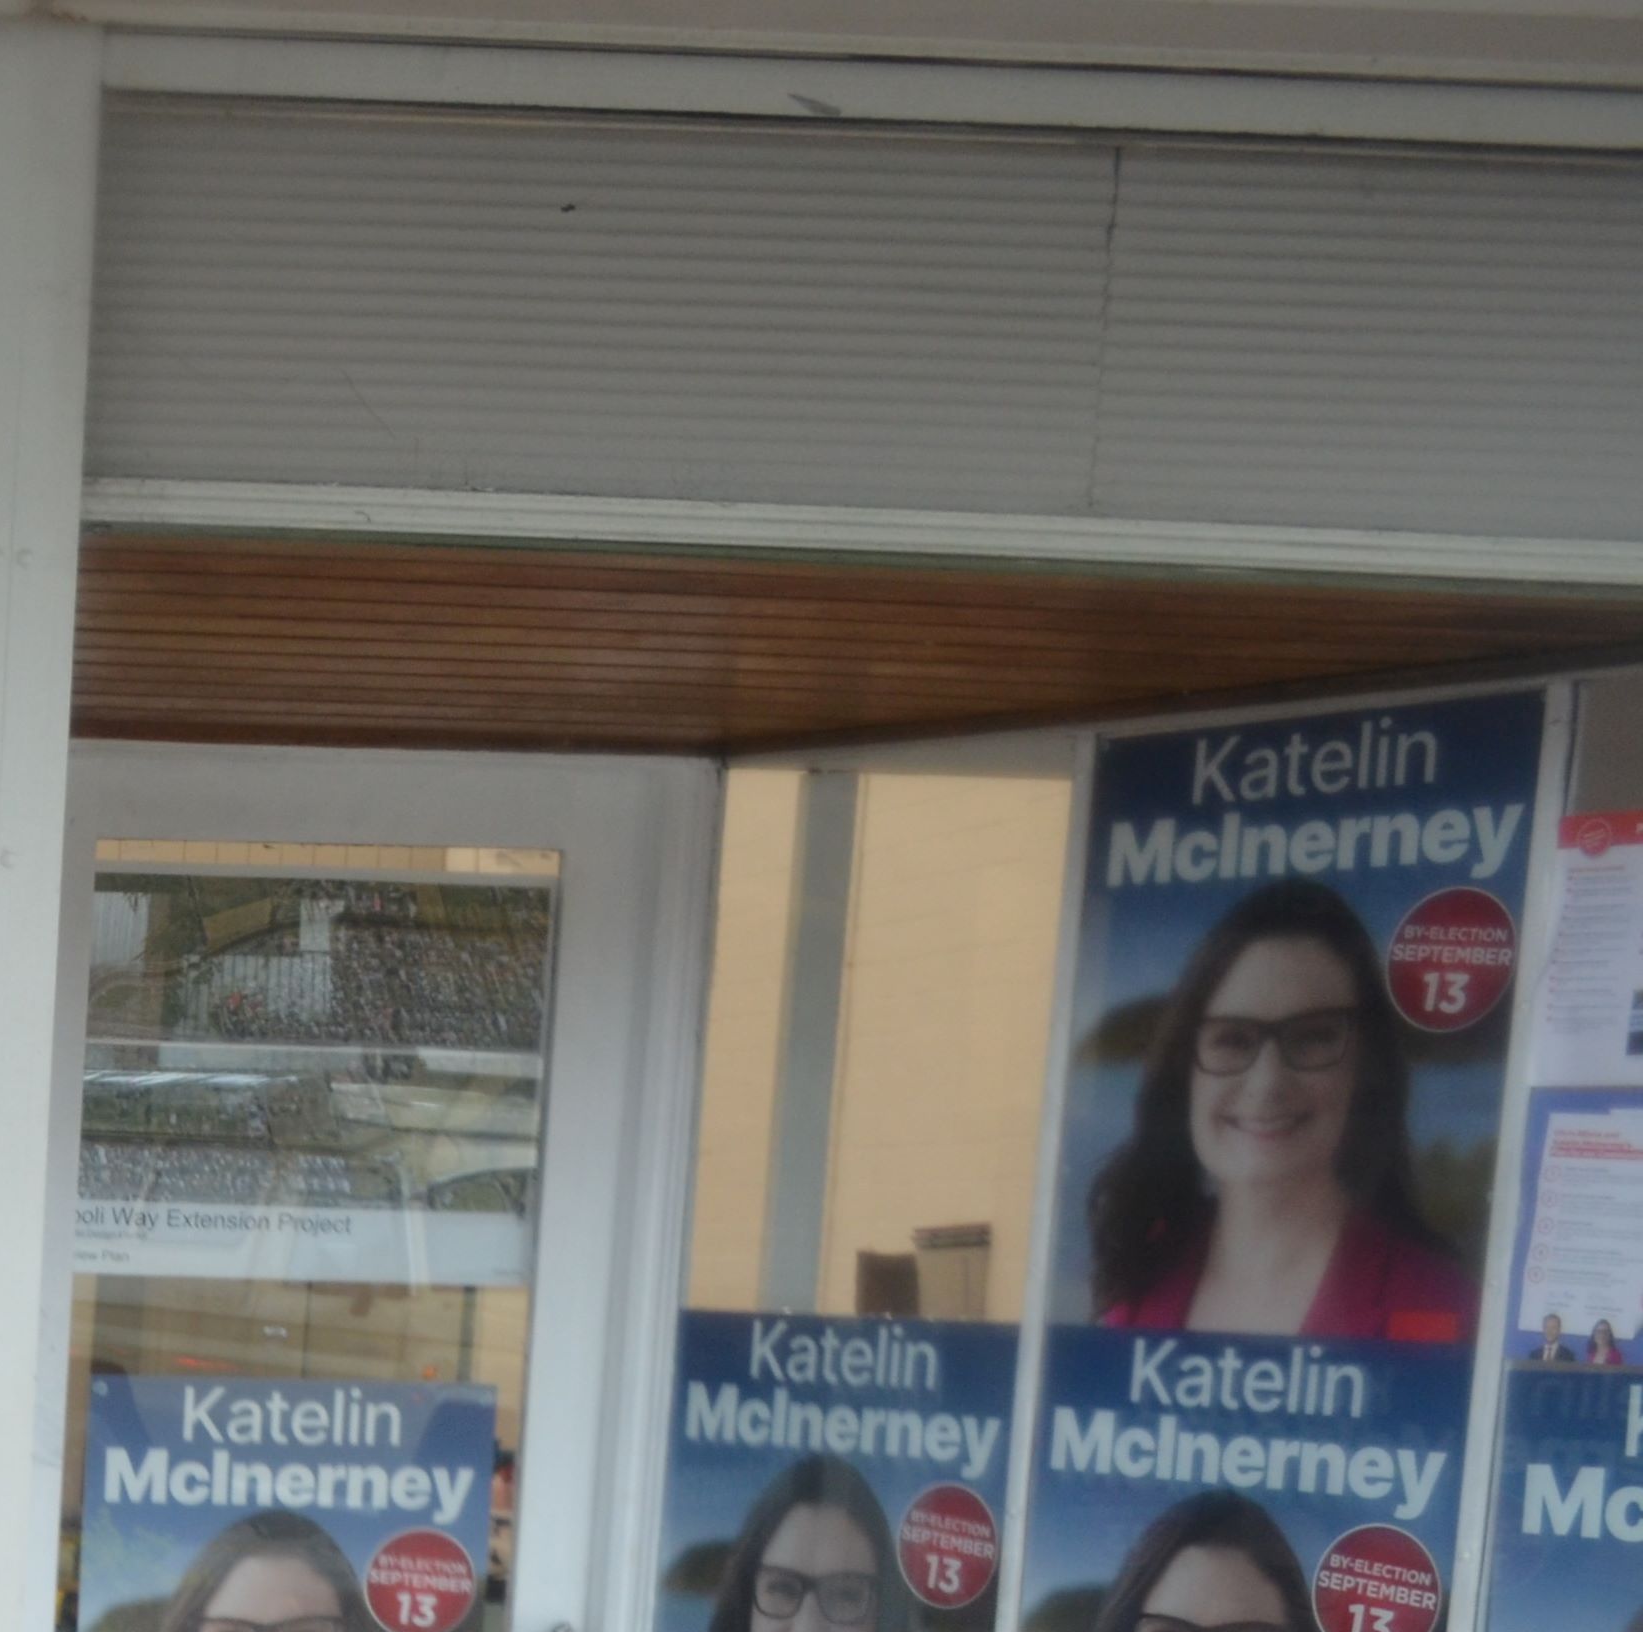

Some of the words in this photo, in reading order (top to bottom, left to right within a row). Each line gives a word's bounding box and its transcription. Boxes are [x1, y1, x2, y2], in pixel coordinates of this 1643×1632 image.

[1192, 716, 1438, 805] Katelin
[1107, 803, 1524, 888] McInerney
[1404, 925, 1507, 943] BY-ELECTION
[1392, 945, 1513, 966] SEPTEMBER
[1423, 972, 1467, 1014] 13
[112, 1209, 158, 1233] Way
[167, 1209, 270, 1233] Extension
[278, 1213, 352, 1237] Project
[749, 1320, 938, 1391] Katelin
[1129, 1338, 1364, 1418] Katelin
[182, 1386, 402, 1447] Katelin
[686, 1381, 1000, 1479] McInerney
[1049, 1406, 1447, 1519] McInerney
[103, 1448, 473, 1524] McInerney
[911, 1510, 989, 1537] BY-ELECTION
[901, 1527, 995, 1560] SEPTEMBER
[368, 1569, 473, 1594] SEPTEMBER
[377, 1553, 467, 1574] BY-ELECTION
[926, 1554, 961, 1592] 13
[1330, 1553, 1432, 1586] BY-ELECTION
[1318, 1571, 1436, 1610] SEPTEMBER
[397, 1593, 436, 1628] 13
